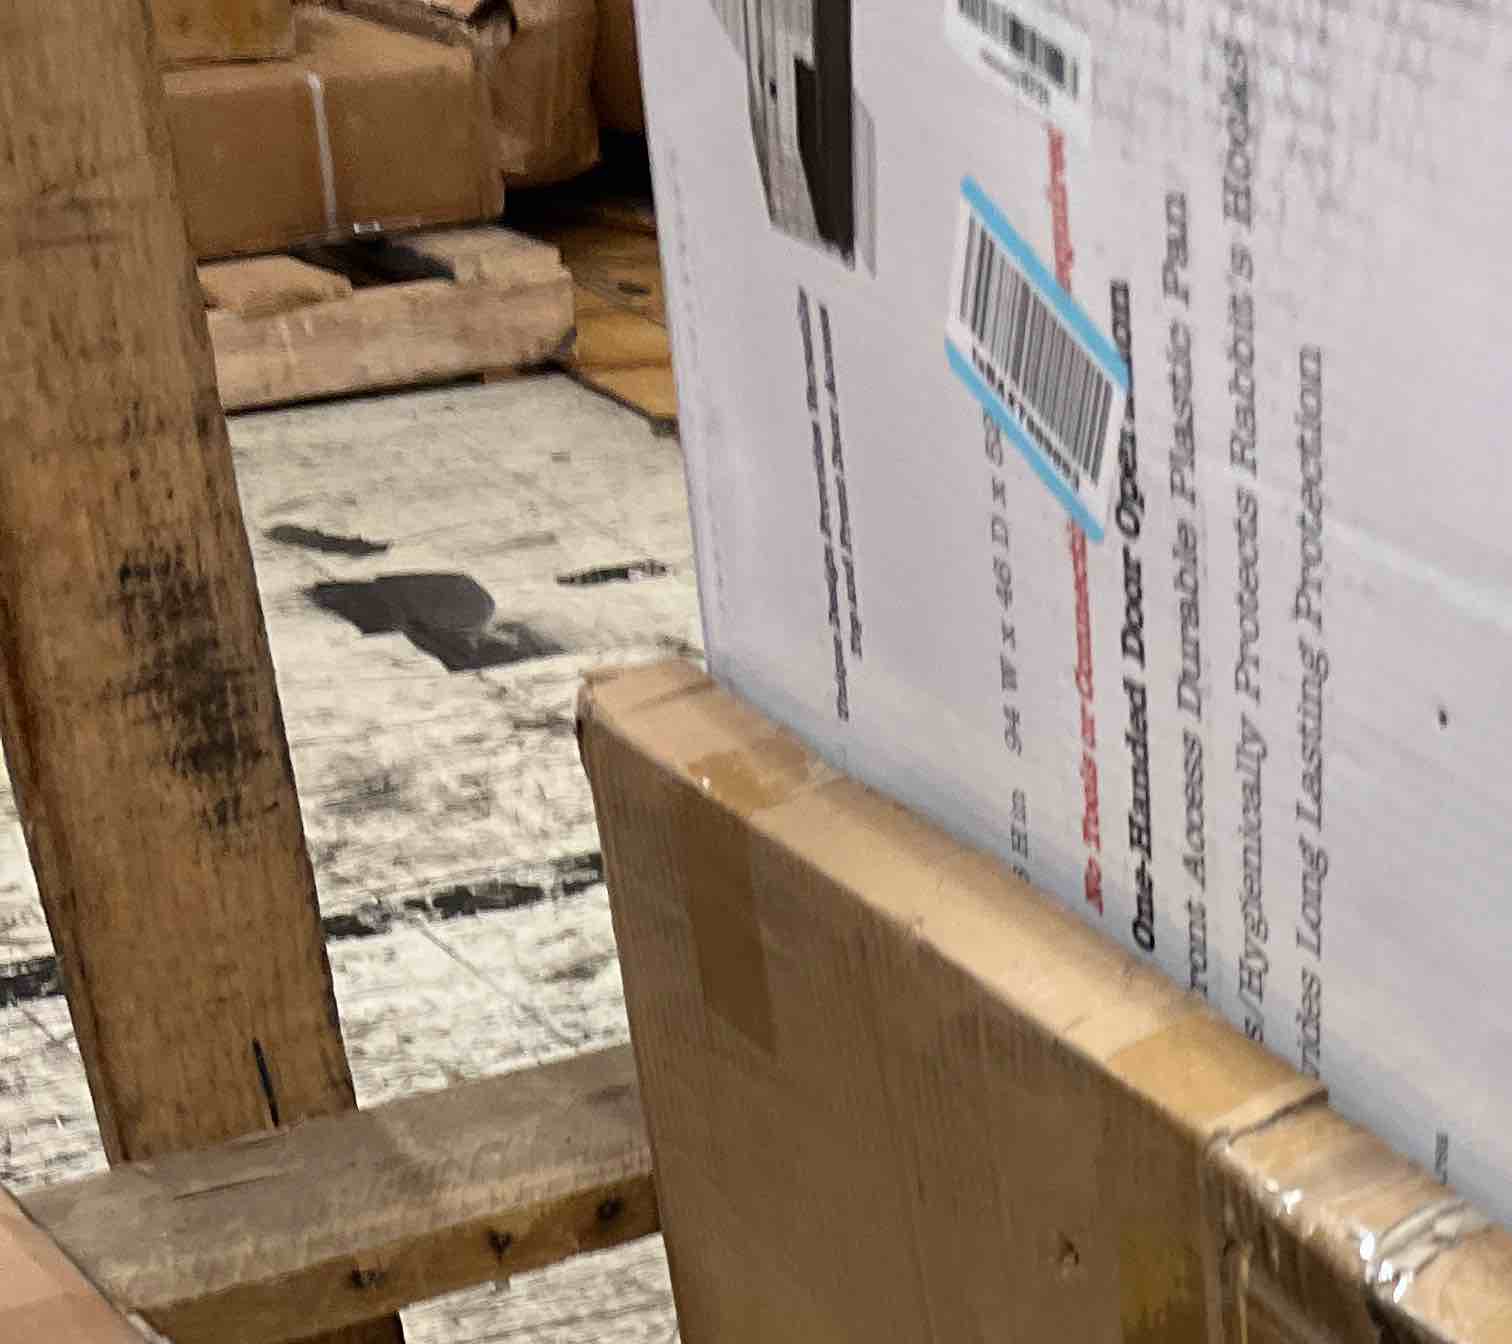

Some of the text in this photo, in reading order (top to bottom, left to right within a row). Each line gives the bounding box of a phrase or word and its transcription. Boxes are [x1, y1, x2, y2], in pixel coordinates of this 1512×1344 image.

[1227, 240, 1258, 478] Rabbit's
[1119, 544, 1146, 670] Door
[1162, 193, 1209, 999] ront Access Durable Plastic Pan
[1234, 488, 1262, 702] Protects
[1292, 345, 1330, 963] Long Lasting Protection
[1120, 676, 1156, 953] One-Handed
